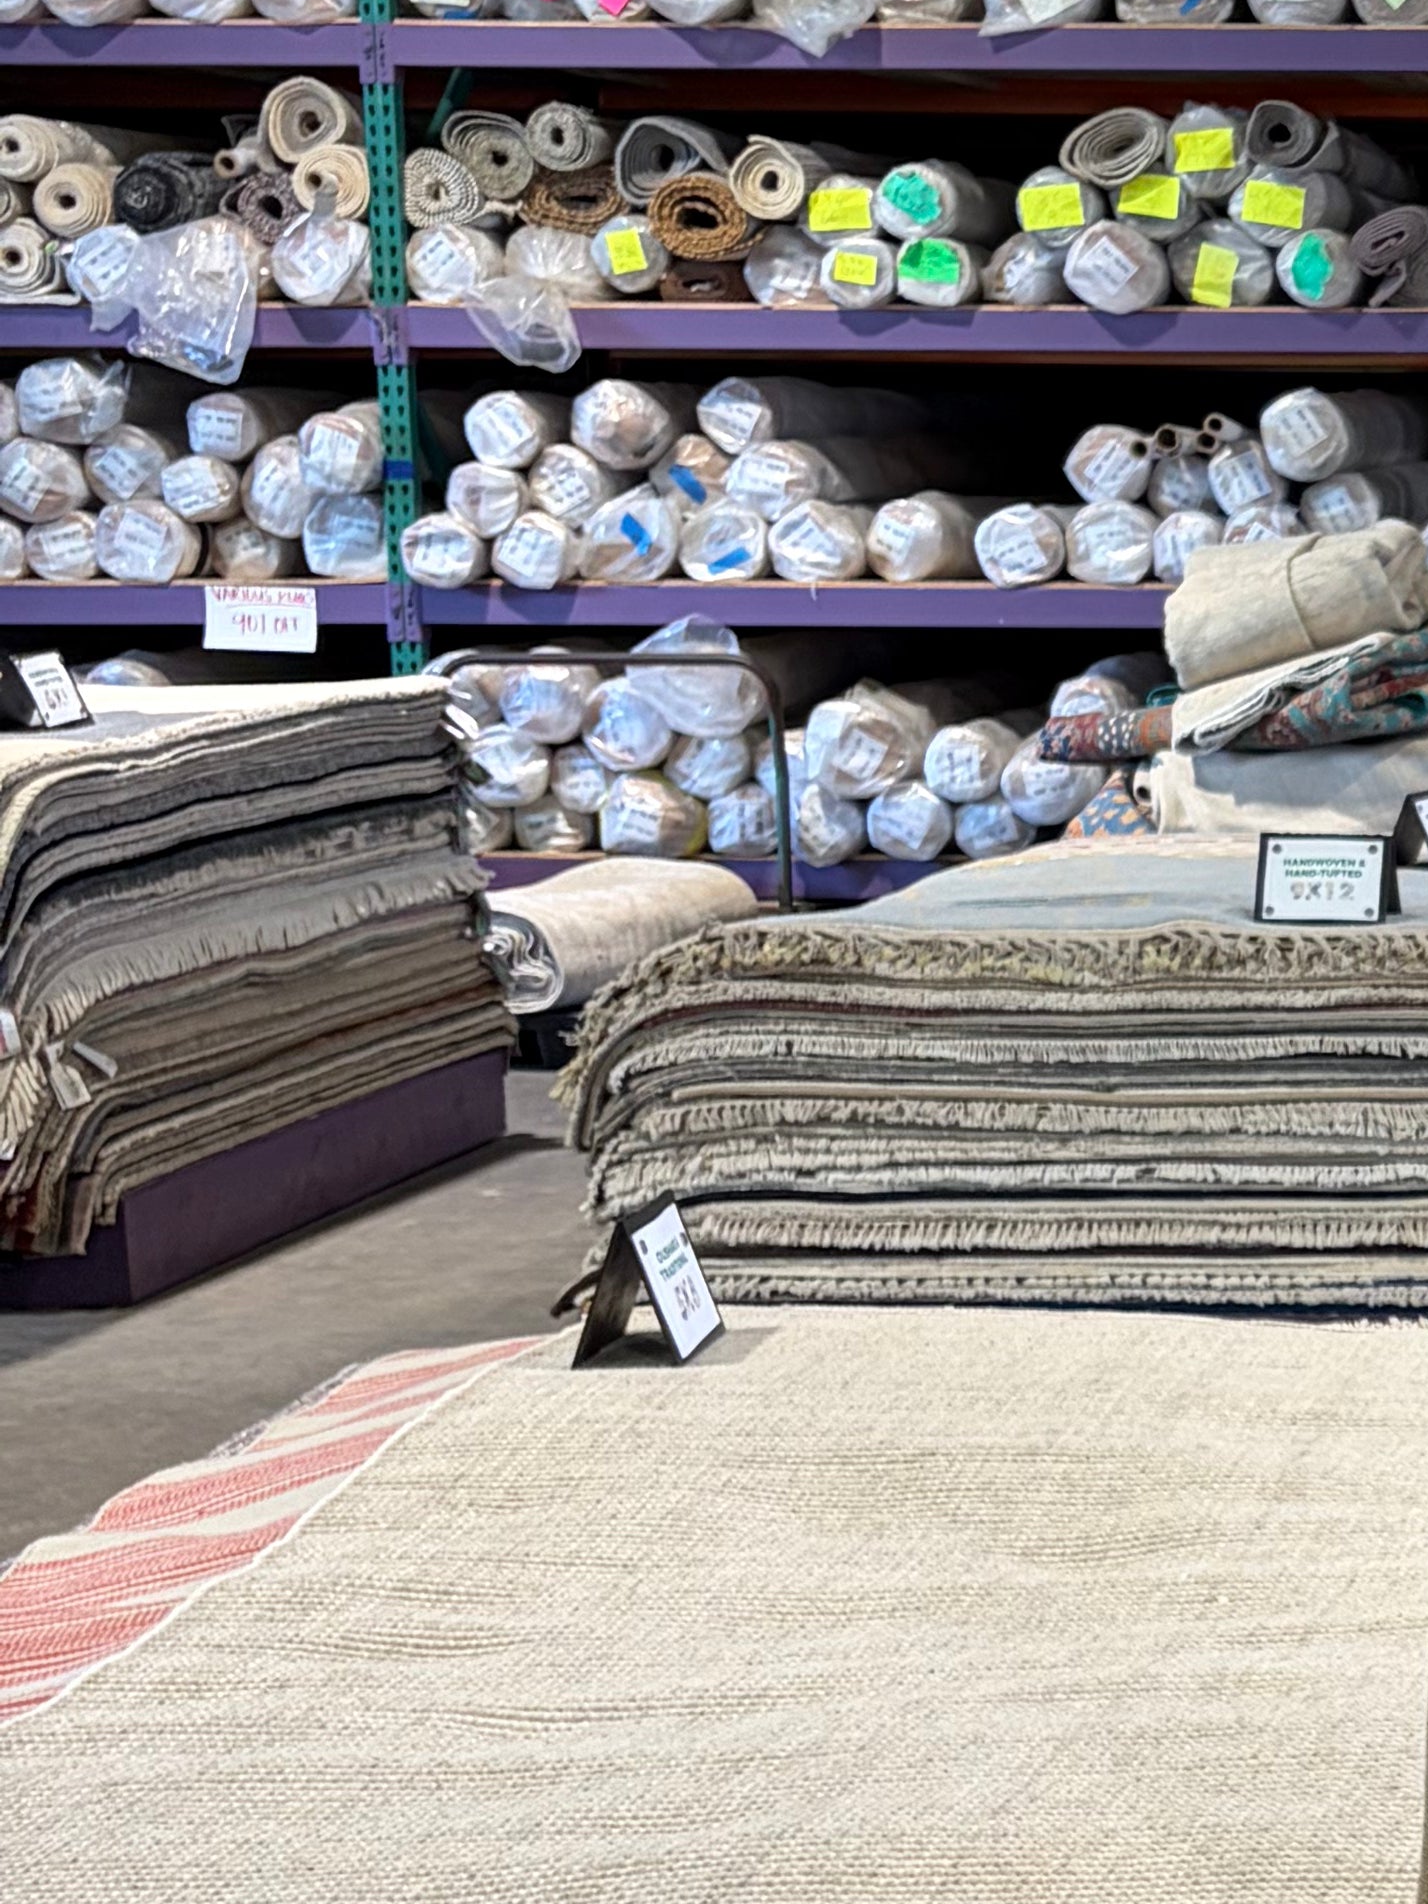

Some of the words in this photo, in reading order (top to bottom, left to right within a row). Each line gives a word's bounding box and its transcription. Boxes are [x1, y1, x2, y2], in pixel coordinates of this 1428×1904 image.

[1283, 858, 1356, 868] HANDWOVEN
[1285, 869, 1362, 879] HAND-TUFTED
[1290, 881, 1355, 901] 9X12
